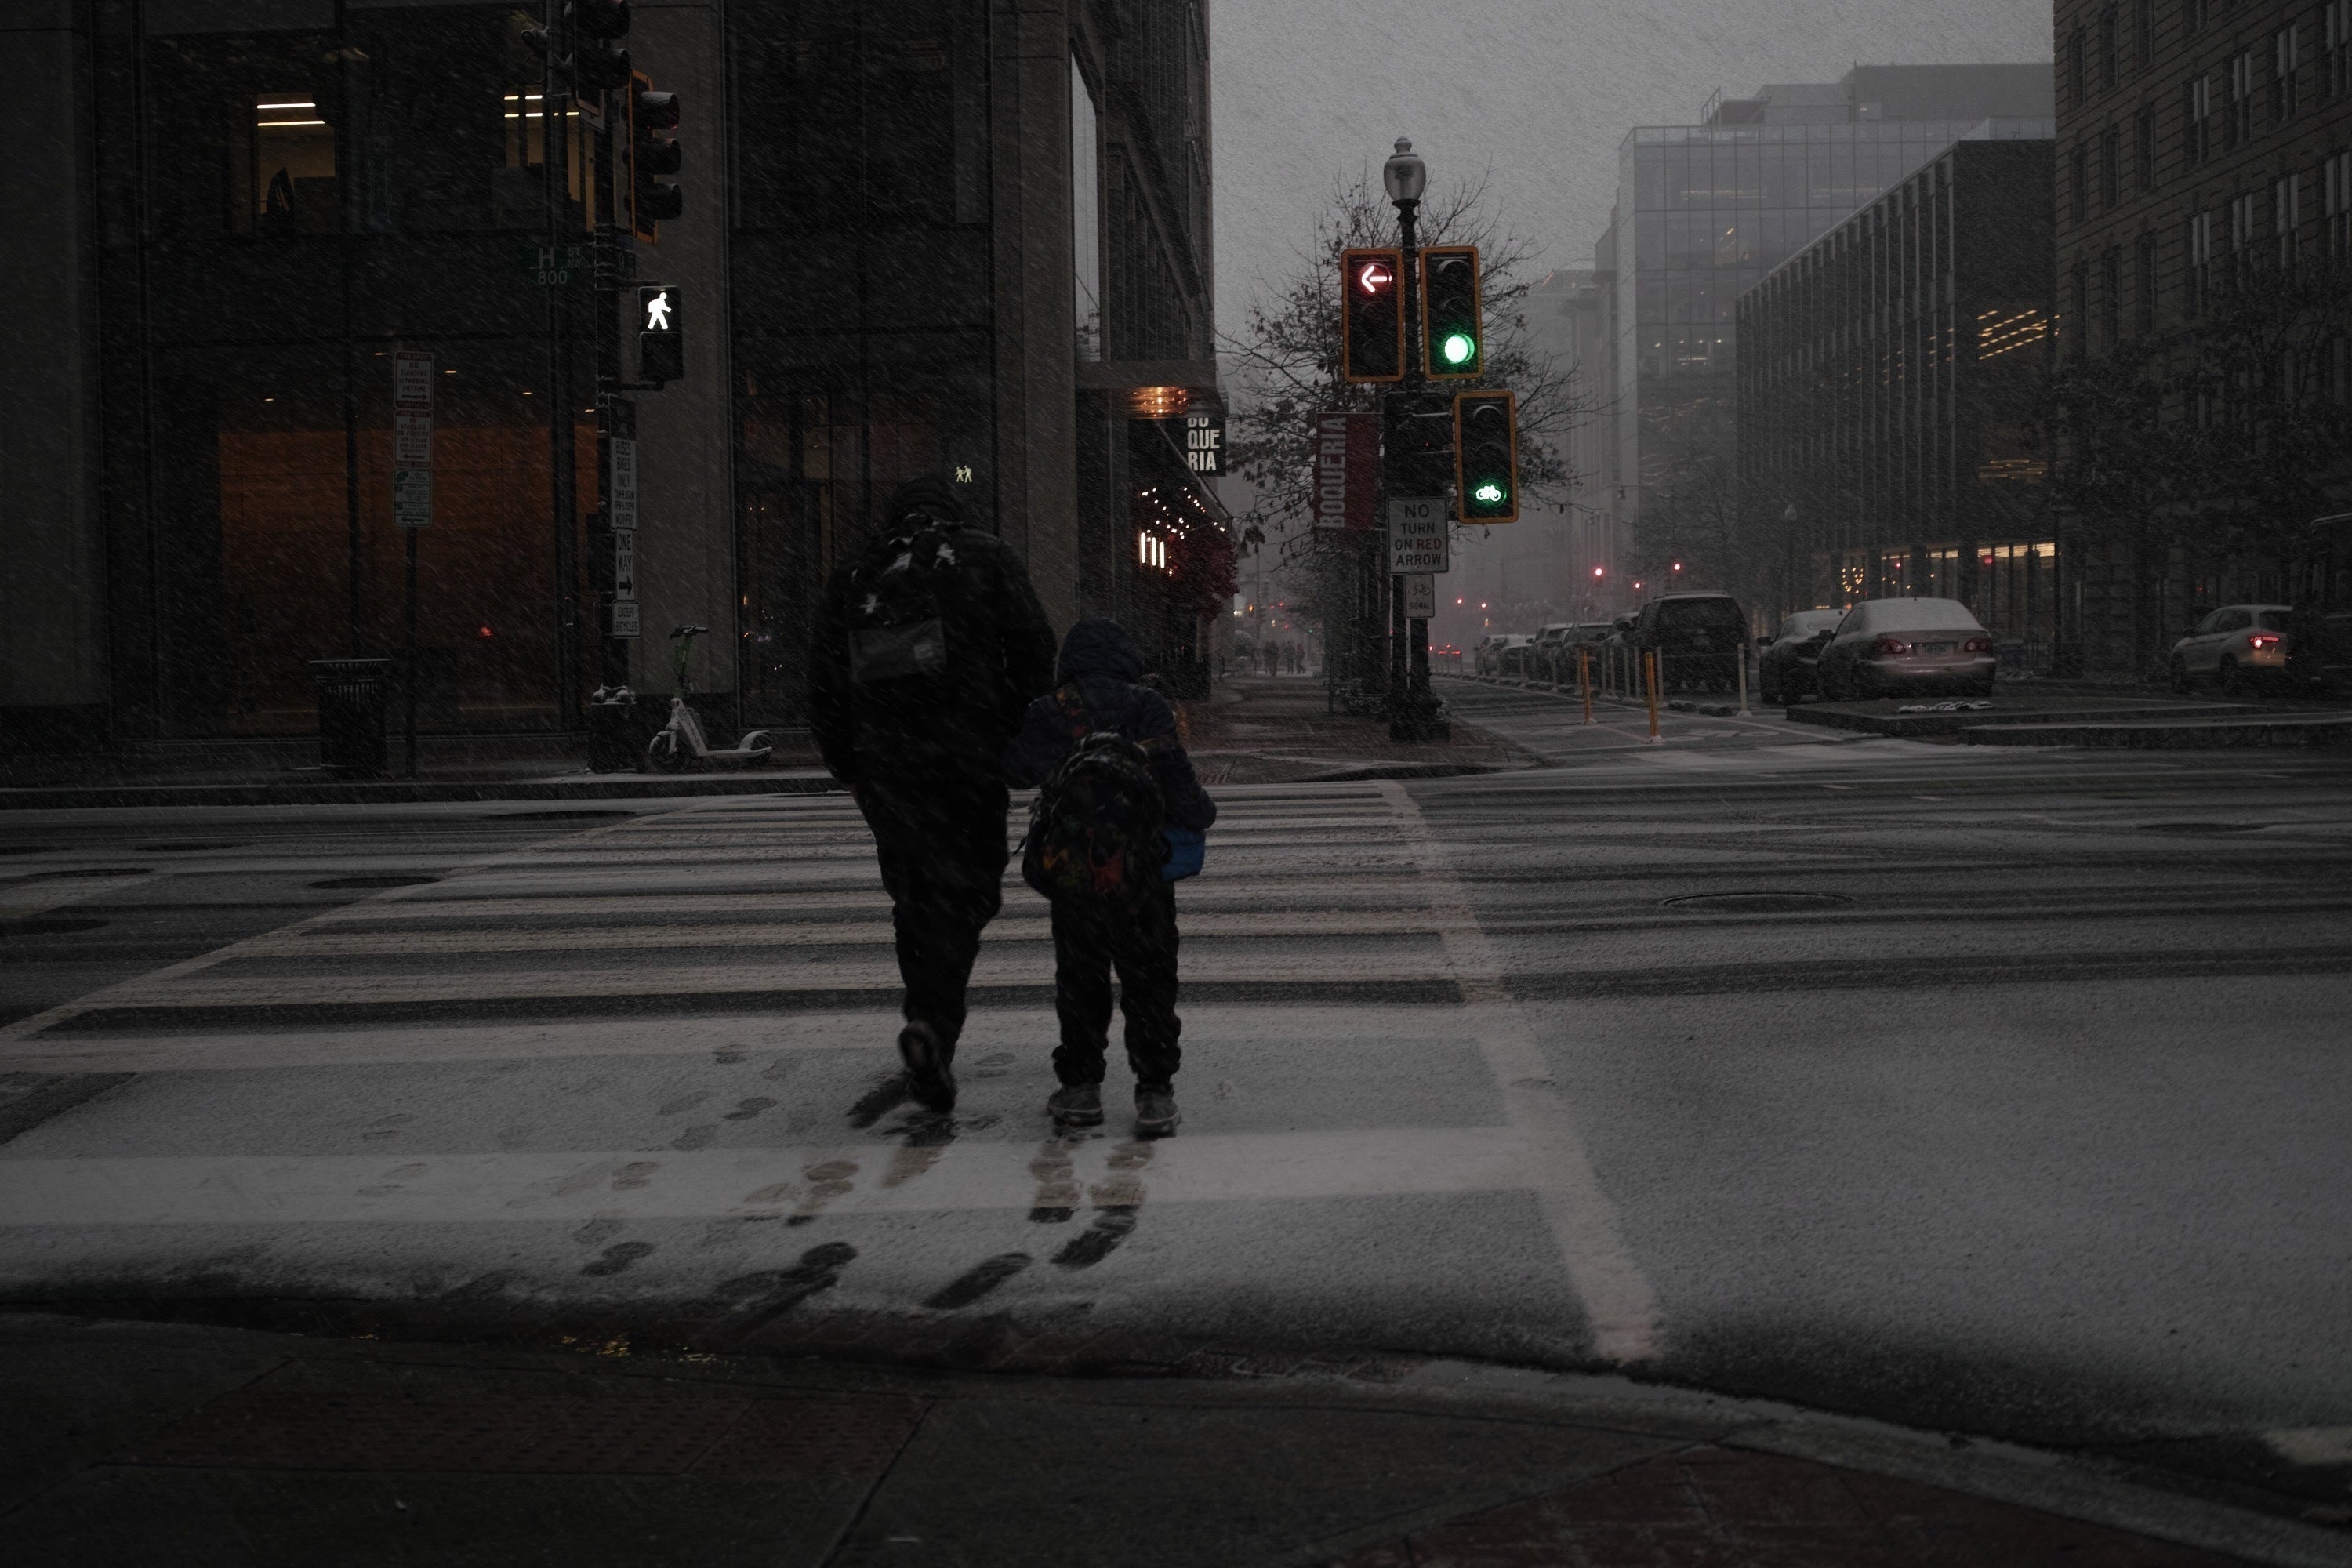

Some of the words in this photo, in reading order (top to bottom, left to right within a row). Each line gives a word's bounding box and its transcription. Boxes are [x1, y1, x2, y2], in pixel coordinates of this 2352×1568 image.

[539, 247, 554, 268] H
[539, 270, 567, 285] 800
[1187, 429, 1221, 449] QUE
[1187, 451, 1216, 471] RIA
[1319, 417, 1346, 528] BOQUERIA
[1404, 504, 1430, 518] NO
[1400, 523, 1435, 534] TURN
[618, 533, 631, 550] ONE
[1395, 539, 1412, 550] ON
[1417, 539, 1442, 550] RED
[618, 554, 632, 572] WAY
[1396, 554, 1441, 566] ARROW
[618, 606, 634, 618] EXCEPT
[1409, 601, 1431, 610] SIGNAL
[615, 621, 638, 632] BICYCLES
